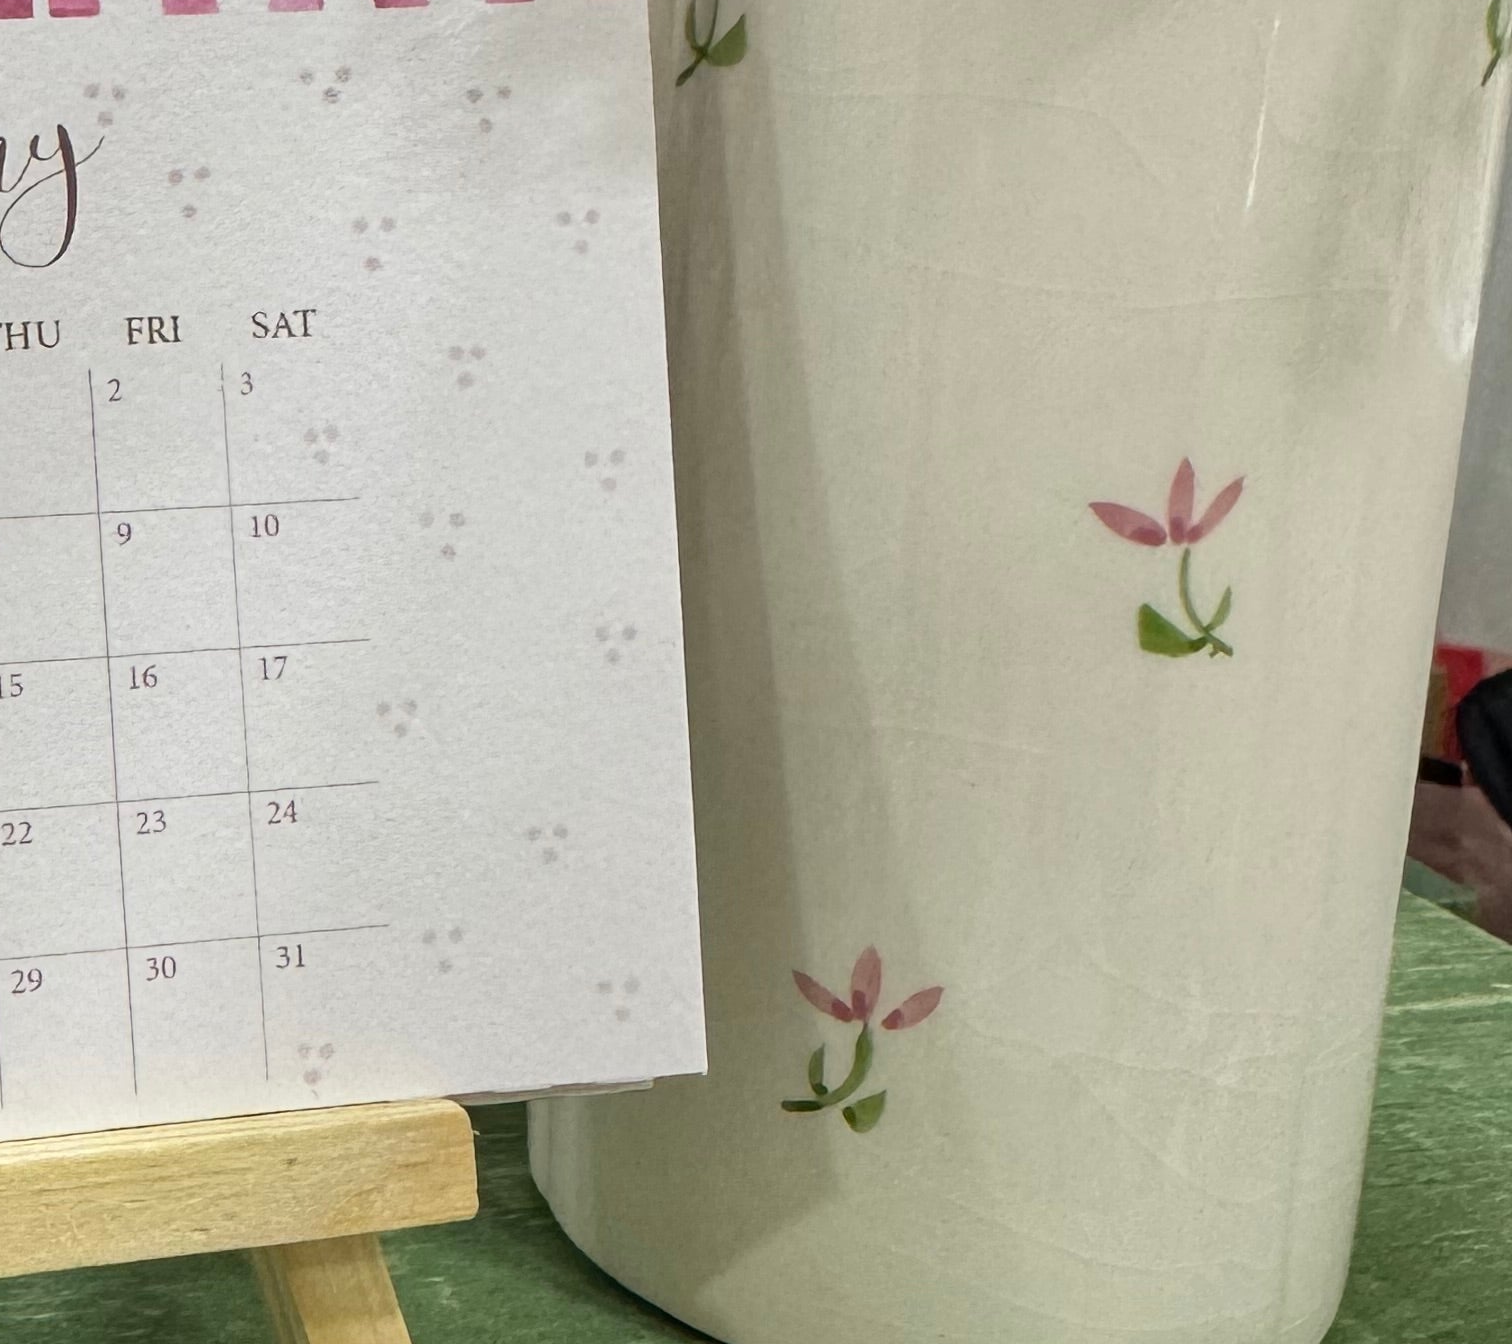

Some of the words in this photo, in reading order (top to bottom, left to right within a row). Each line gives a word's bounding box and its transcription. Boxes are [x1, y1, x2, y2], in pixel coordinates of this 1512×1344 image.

[123, 314, 184, 346] FRI
[250, 308, 318, 339] SAT
[106, 377, 123, 403] 2
[240, 371, 254, 396] 3
[116, 521, 133, 547] 9
[250, 513, 280, 539] 10
[129, 663, 158, 690] 16
[258, 655, 289, 681] 17
[0, 820, 34, 847] 22
[136, 809, 167, 836] 23
[267, 799, 299, 826] 24
[10, 967, 43, 995] 29
[145, 955, 177, 982] 30
[275, 943, 306, 970] 31
